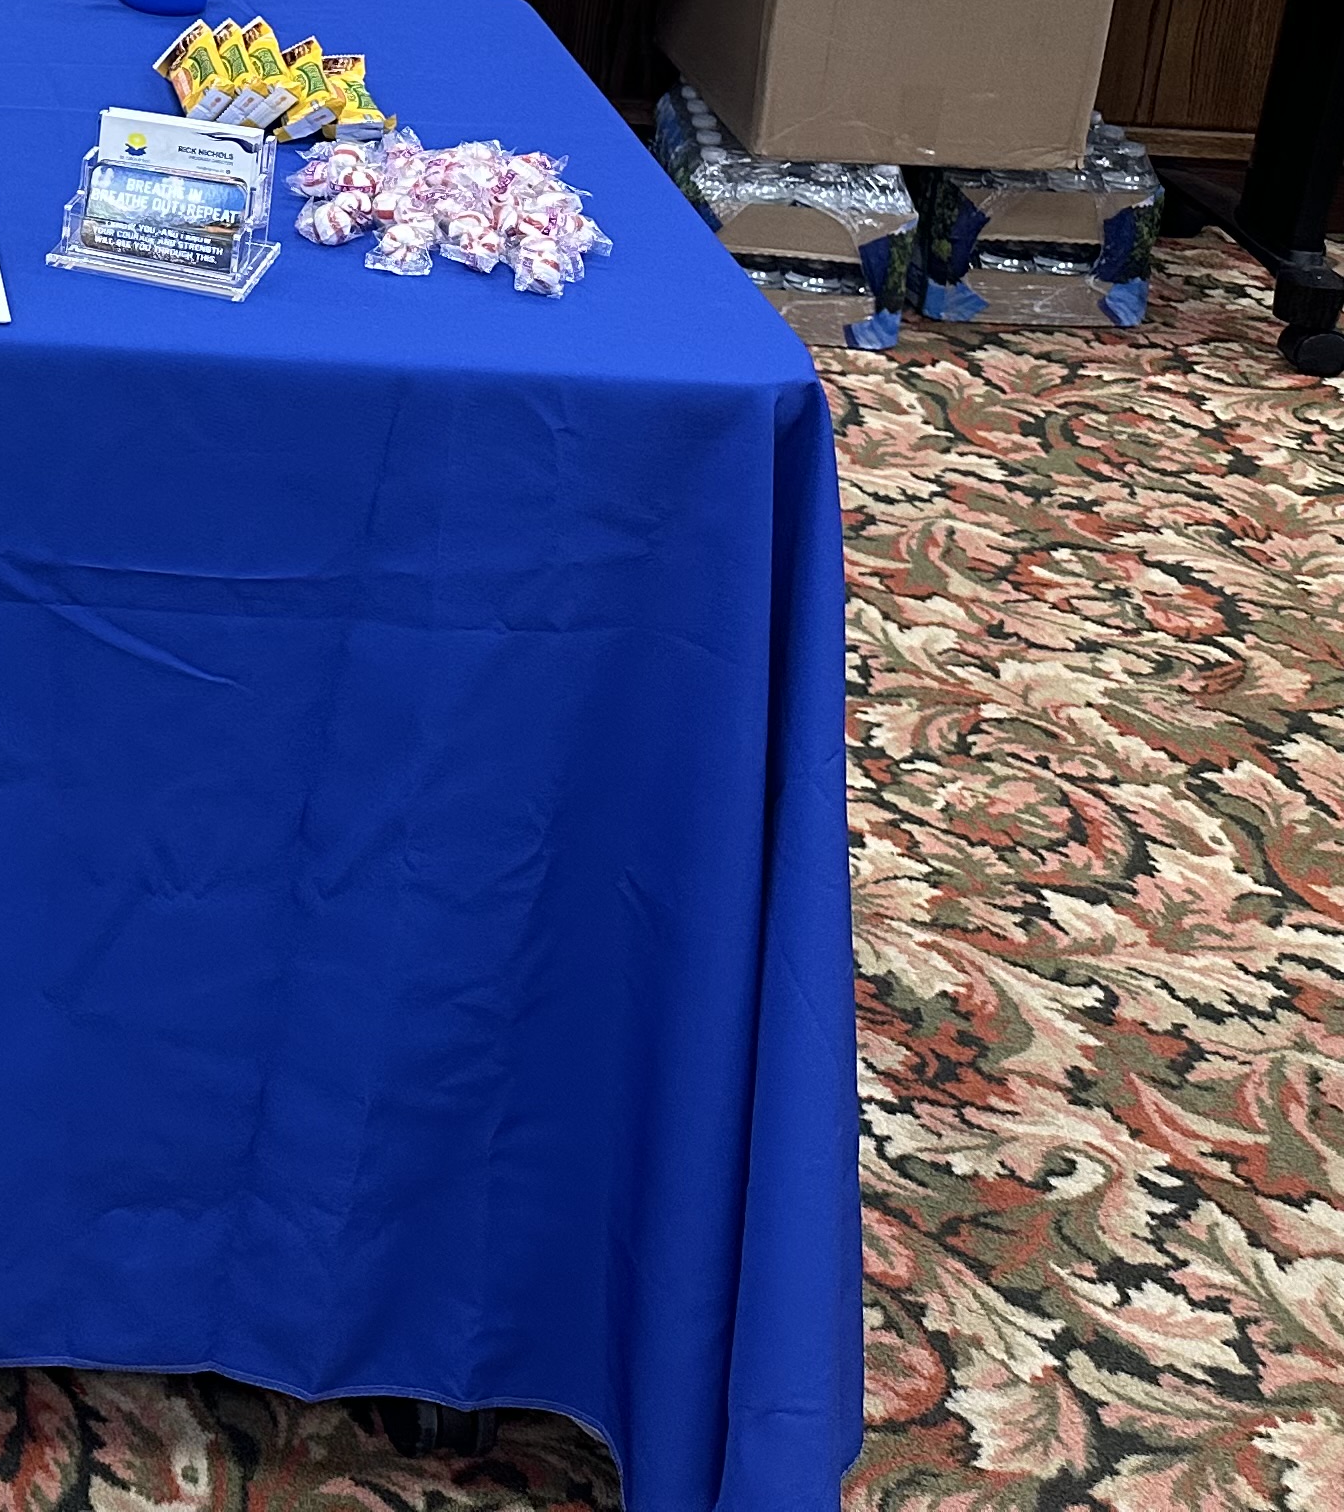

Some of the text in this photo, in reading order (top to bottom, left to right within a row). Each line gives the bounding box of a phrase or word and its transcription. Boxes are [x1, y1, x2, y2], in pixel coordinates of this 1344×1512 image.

[198, 149, 234, 160] NICHOLS
[126, 178, 186, 199] BREATHE
[91, 189, 148, 209] BREATHE
[186, 204, 239, 224] REPEAT
[94, 226, 115, 237] YOUR
[178, 241, 223, 256] STRENGTH
